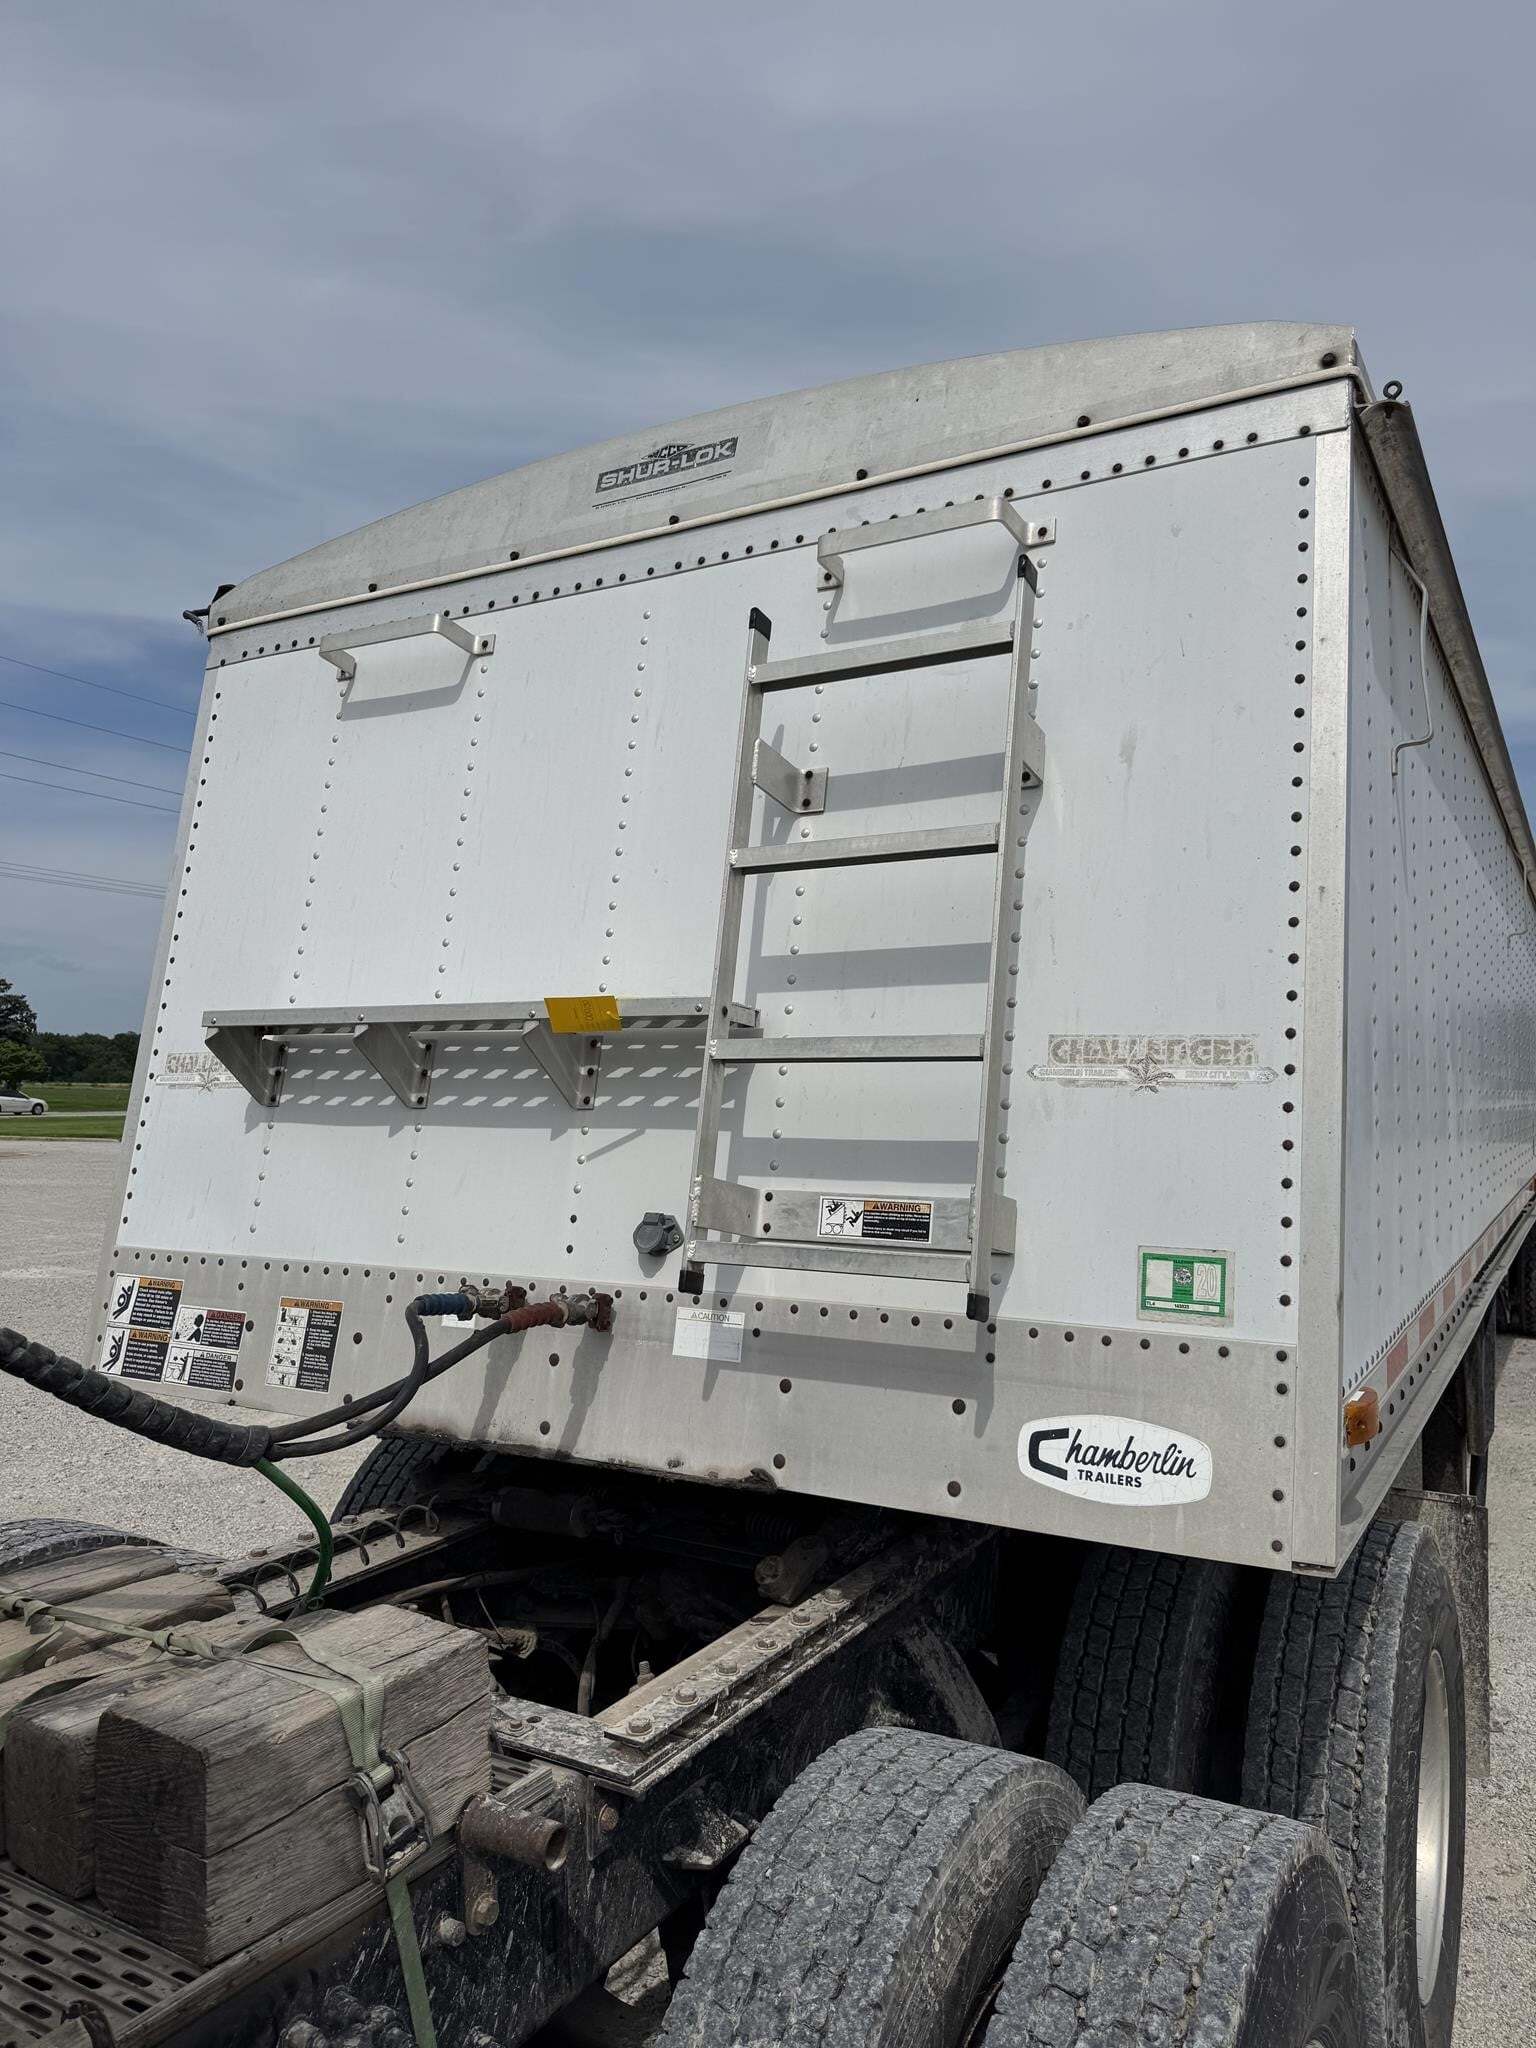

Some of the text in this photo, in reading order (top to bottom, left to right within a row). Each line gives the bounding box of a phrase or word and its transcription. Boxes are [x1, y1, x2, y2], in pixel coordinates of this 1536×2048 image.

[600, 441, 735, 489] SHUR-LOK
[879, 1203, 921, 1213] WARNING
[1196, 1264, 1217, 1298] 20
[301, 1300, 330, 1310] WARNING
[697, 1312, 730, 1322] CAUTION
[138, 1331, 169, 1342] WARNING
[205, 1352, 232, 1361] DANGER
[1028, 1427, 1197, 1481] Chamberlin
[1077, 1469, 1143, 1488] TRAILERS
